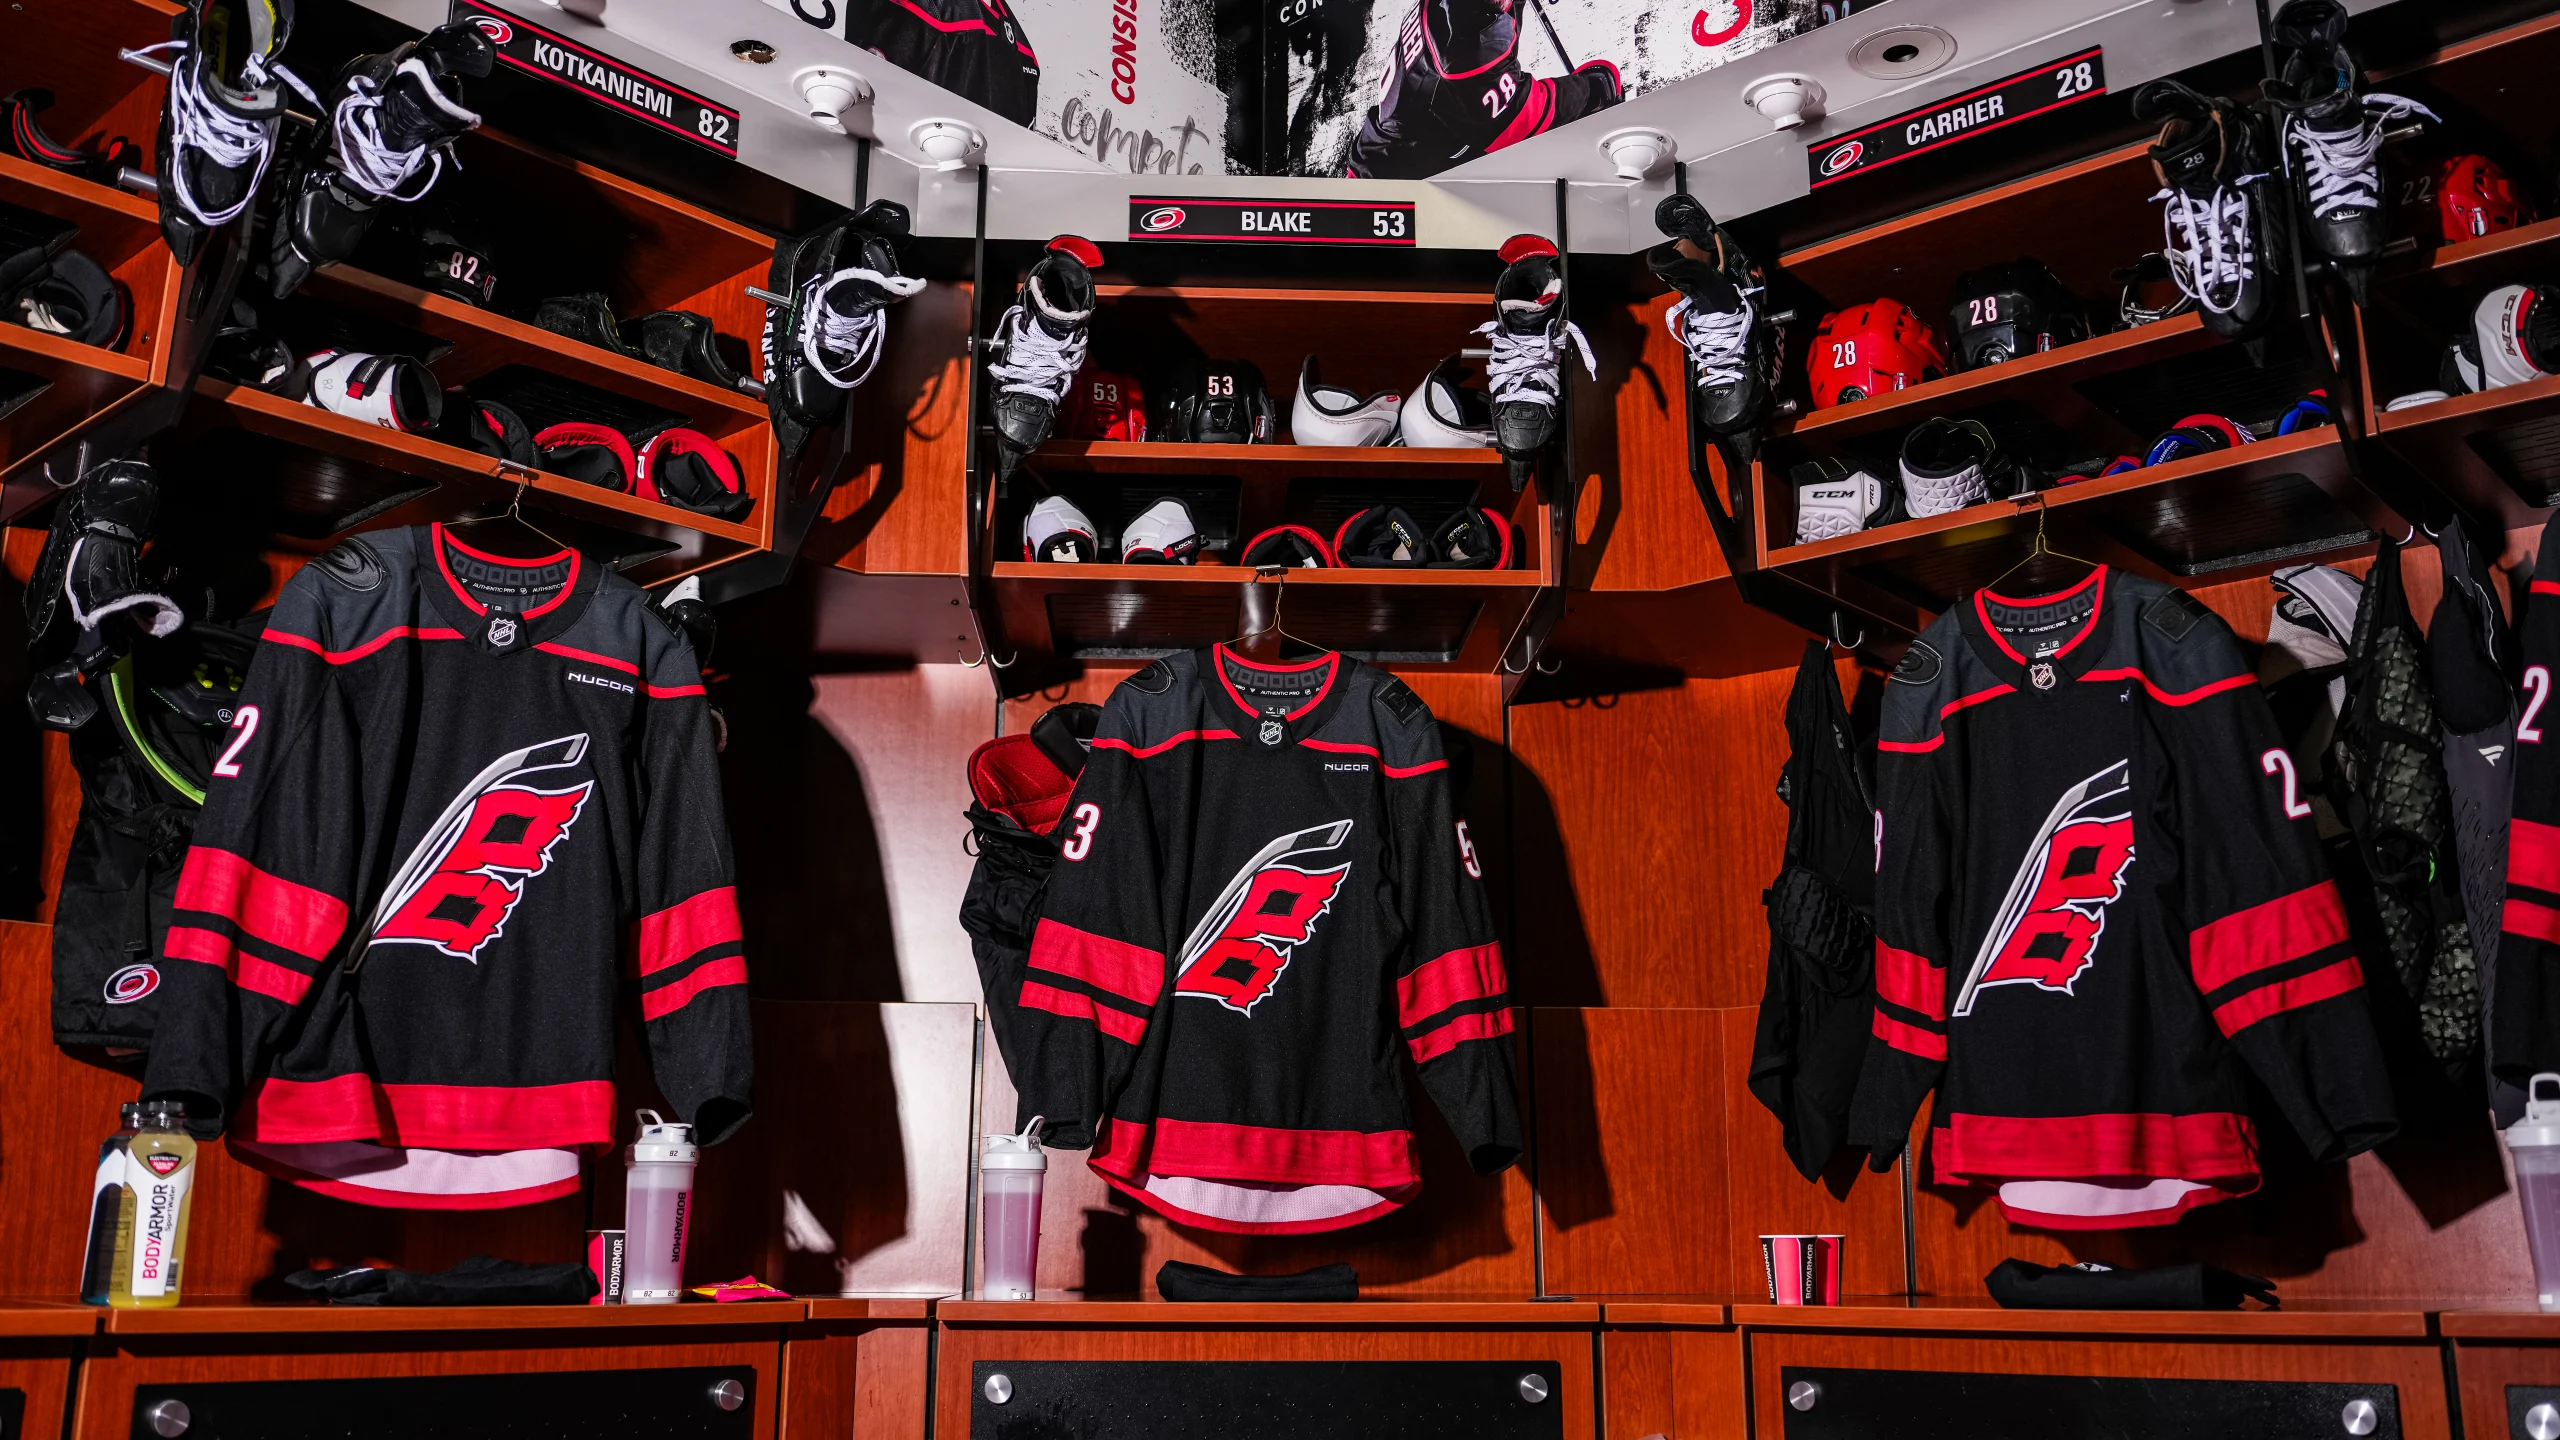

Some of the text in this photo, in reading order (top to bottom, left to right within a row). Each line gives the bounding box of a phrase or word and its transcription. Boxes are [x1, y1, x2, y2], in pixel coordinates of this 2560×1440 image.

[533, 39, 730, 144] KOTKANIEMI 82
[1482, 72, 1518, 119] 28
[1906, 62, 2094, 146] CARRIER 28
[2182, 152, 2206, 169] 28
[2401, 175, 2432, 206] 22
[1241, 211, 1406, 237] BLAKE 53
[449, 251, 479, 285] 82
[1969, 295, 1999, 327] 28
[2499, 293, 2519, 357] CCM
[1832, 340, 1857, 369] 28
[1092, 382, 1118, 402] 53
[1206, 375, 1235, 396] 53
[1811, 490, 1855, 499] CCM
[1868, 483, 1876, 507] PRO
[568, 671, 634, 694] NUCOR
[2516, 664, 2552, 744] 2
[212, 704, 261, 778] 2
[1324, 763, 1370, 772] NUCOR
[2260, 747, 2313, 820] 2
[1062, 802, 1101, 863] 3
[1454, 818, 1483, 881] 5
[142, 1184, 168, 1279] BODYARMOR
[164, 1185, 176, 1232] SportWater
[671, 1192, 687, 1263] BODYARMOR
[609, 1238, 624, 1296] BODYARMOR
[1762, 1243, 1775, 1299] BODYARMOR
[1805, 1243, 1814, 1299] BODYARMOR
